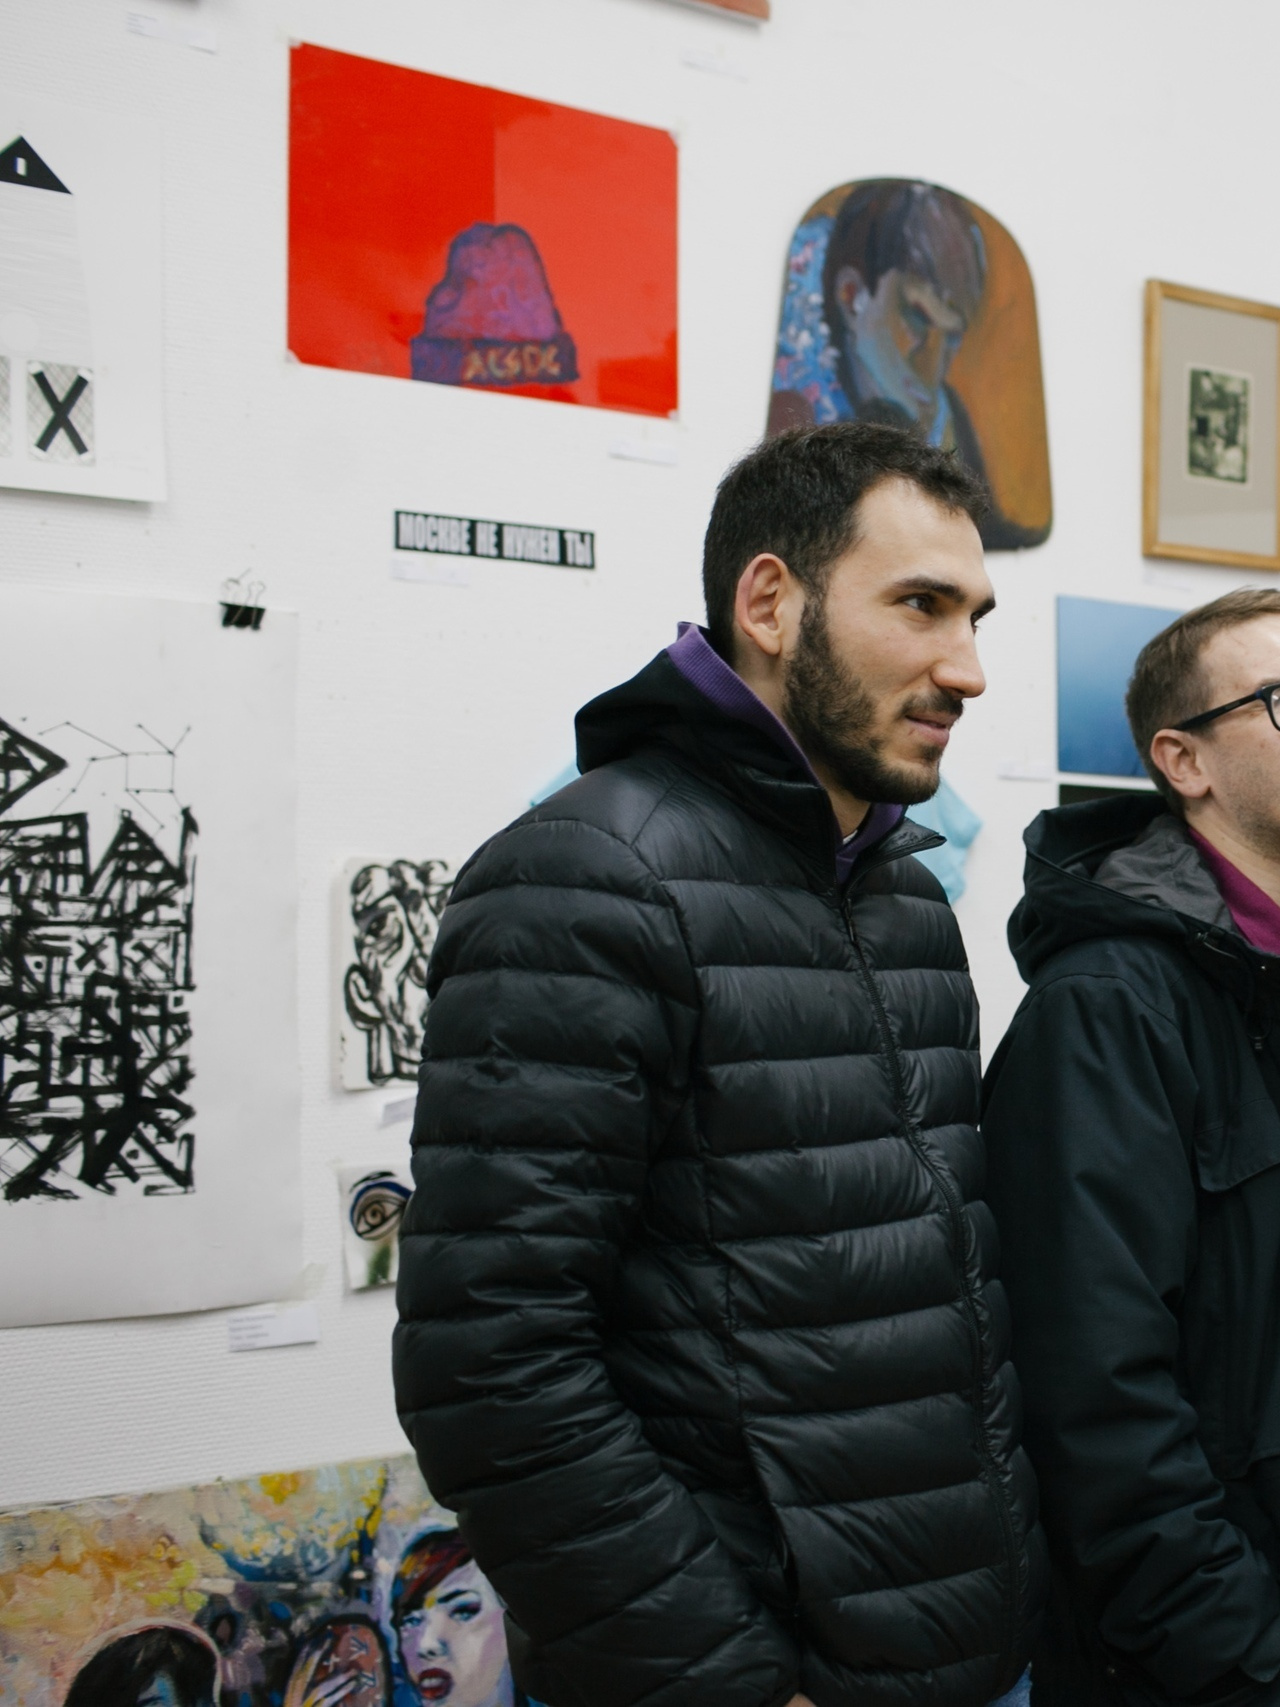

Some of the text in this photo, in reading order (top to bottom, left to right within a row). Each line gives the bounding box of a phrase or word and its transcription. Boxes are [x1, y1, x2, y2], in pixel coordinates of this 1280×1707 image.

[398, 514, 593, 567] МОСКВЕ НЕ НУЖЕН ТЫ
